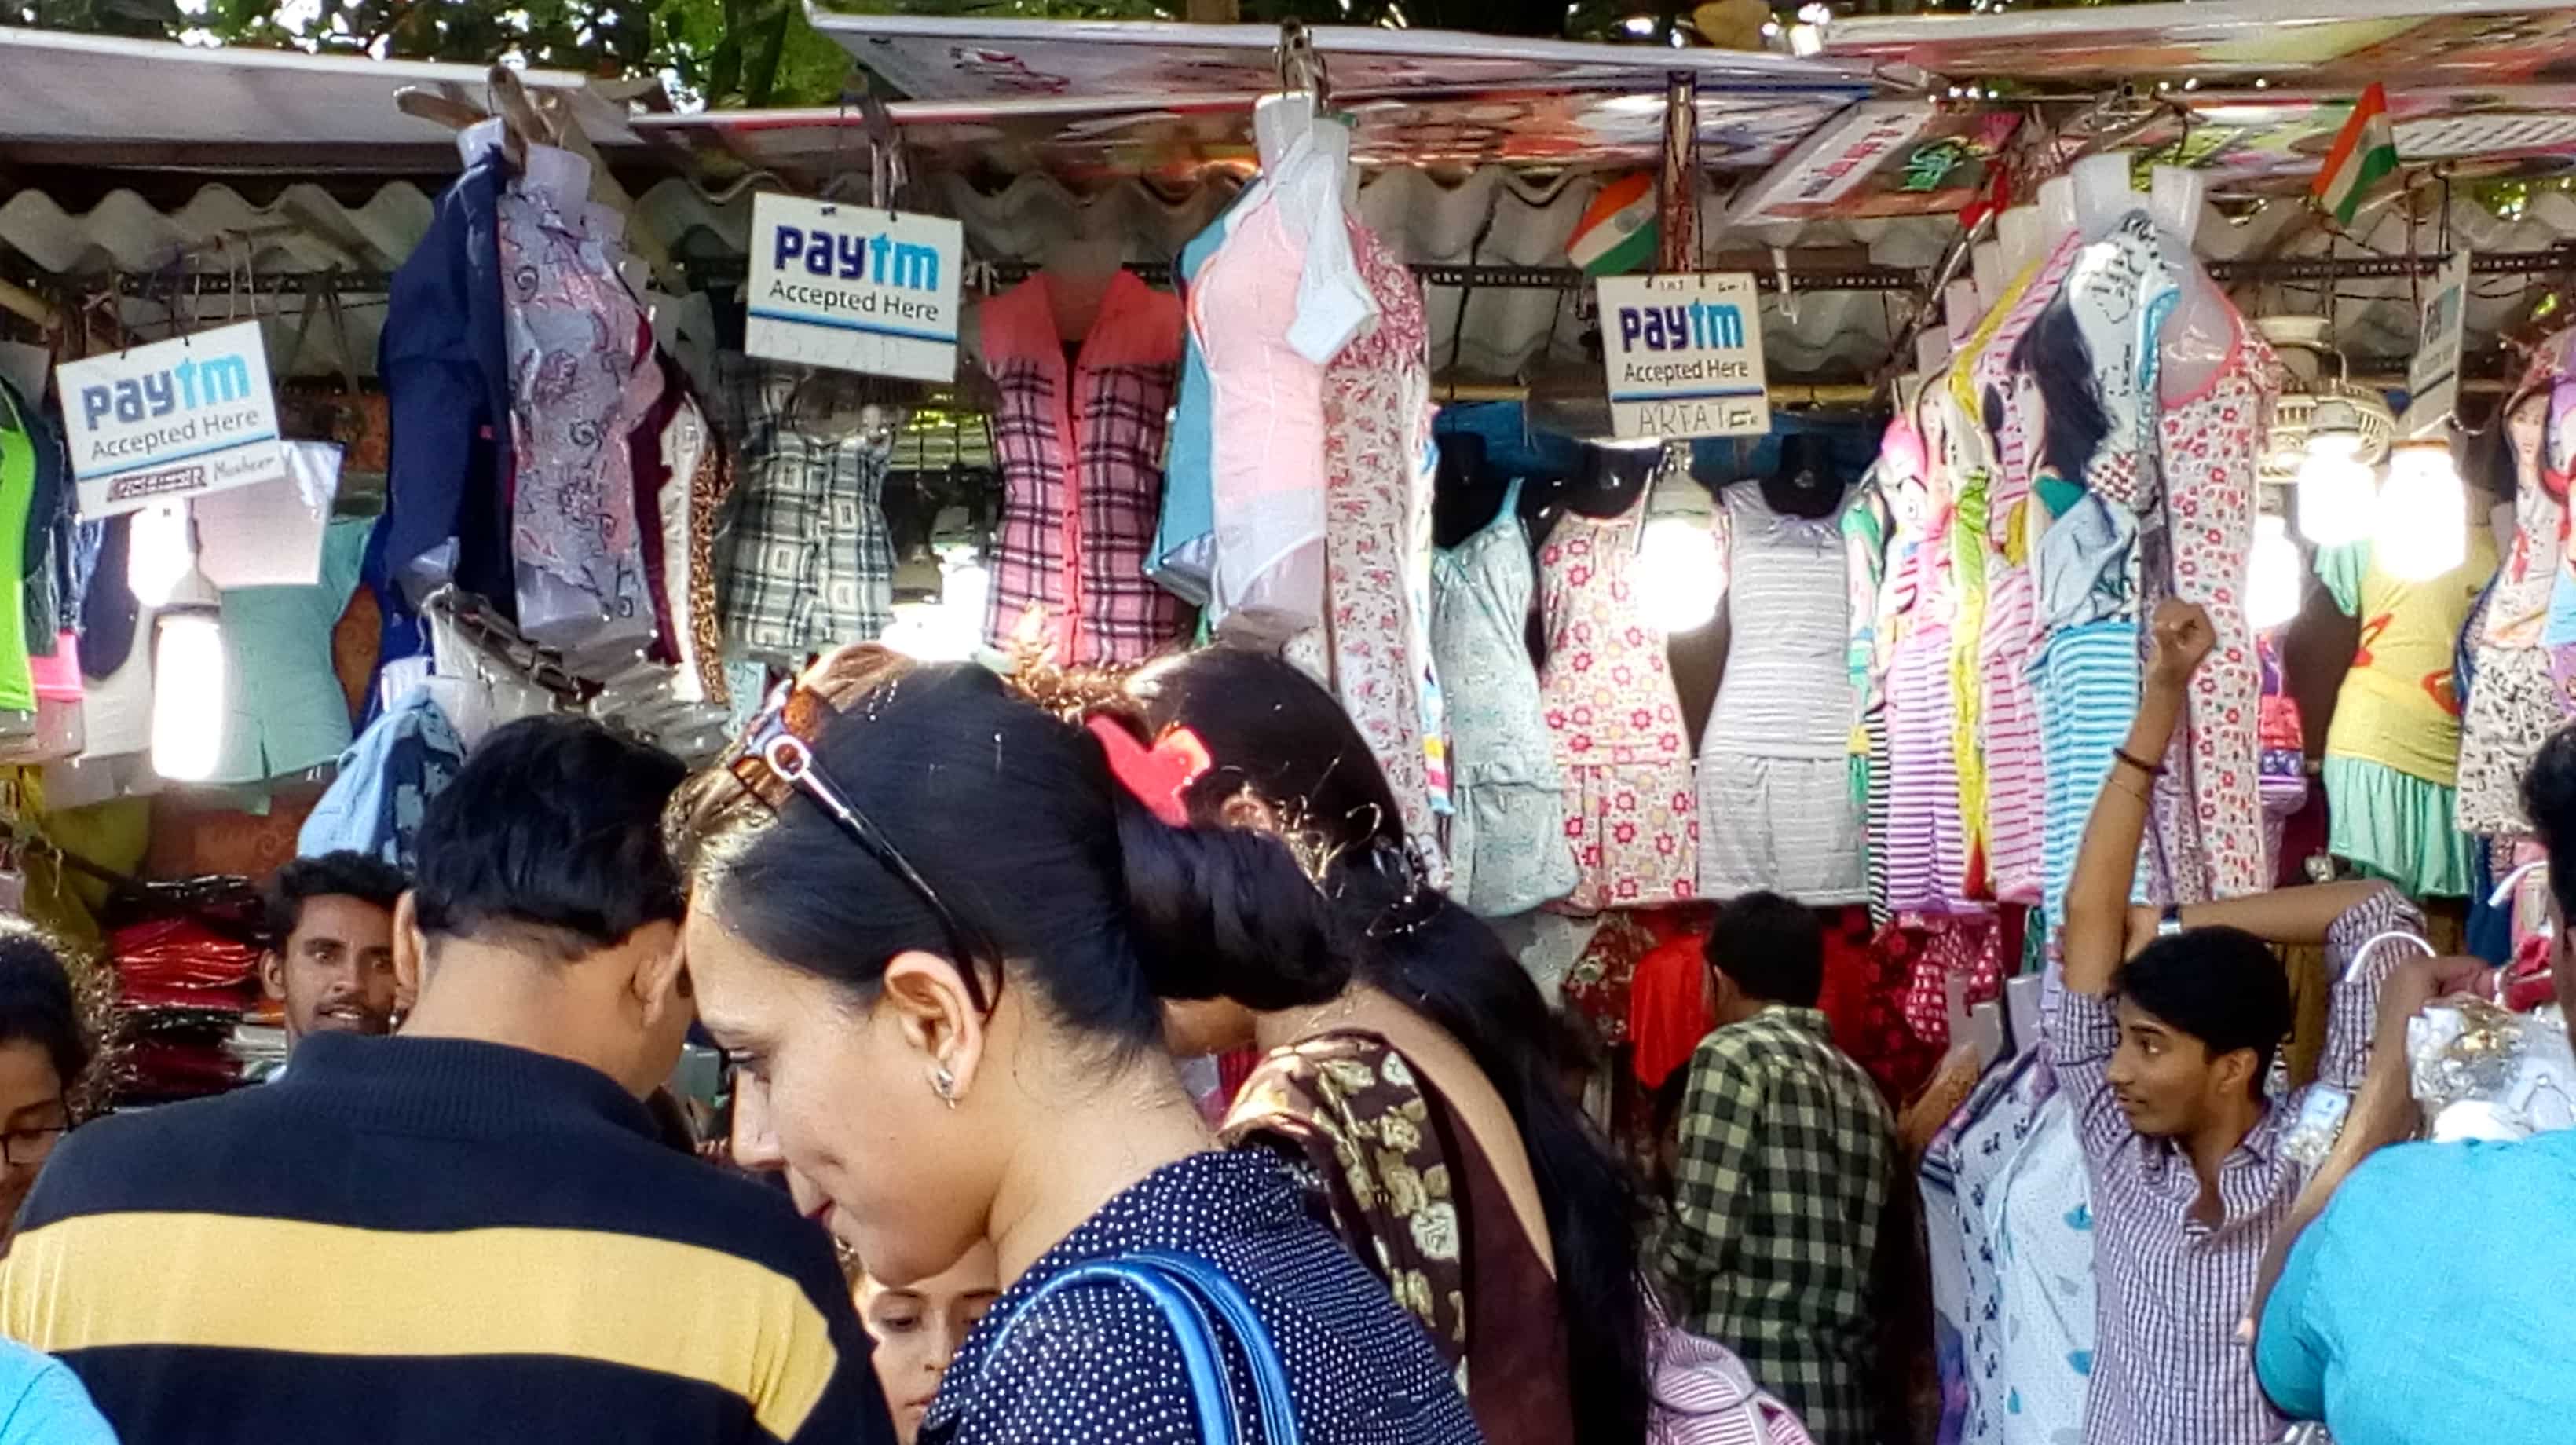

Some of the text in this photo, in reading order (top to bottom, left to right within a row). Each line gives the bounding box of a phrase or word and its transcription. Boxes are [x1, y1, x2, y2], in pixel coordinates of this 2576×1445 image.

[769, 279, 939, 322] Accepted Here
[1623, 360, 1749, 386] Accepted Here
[92, 410, 258, 460] Accepted Here
